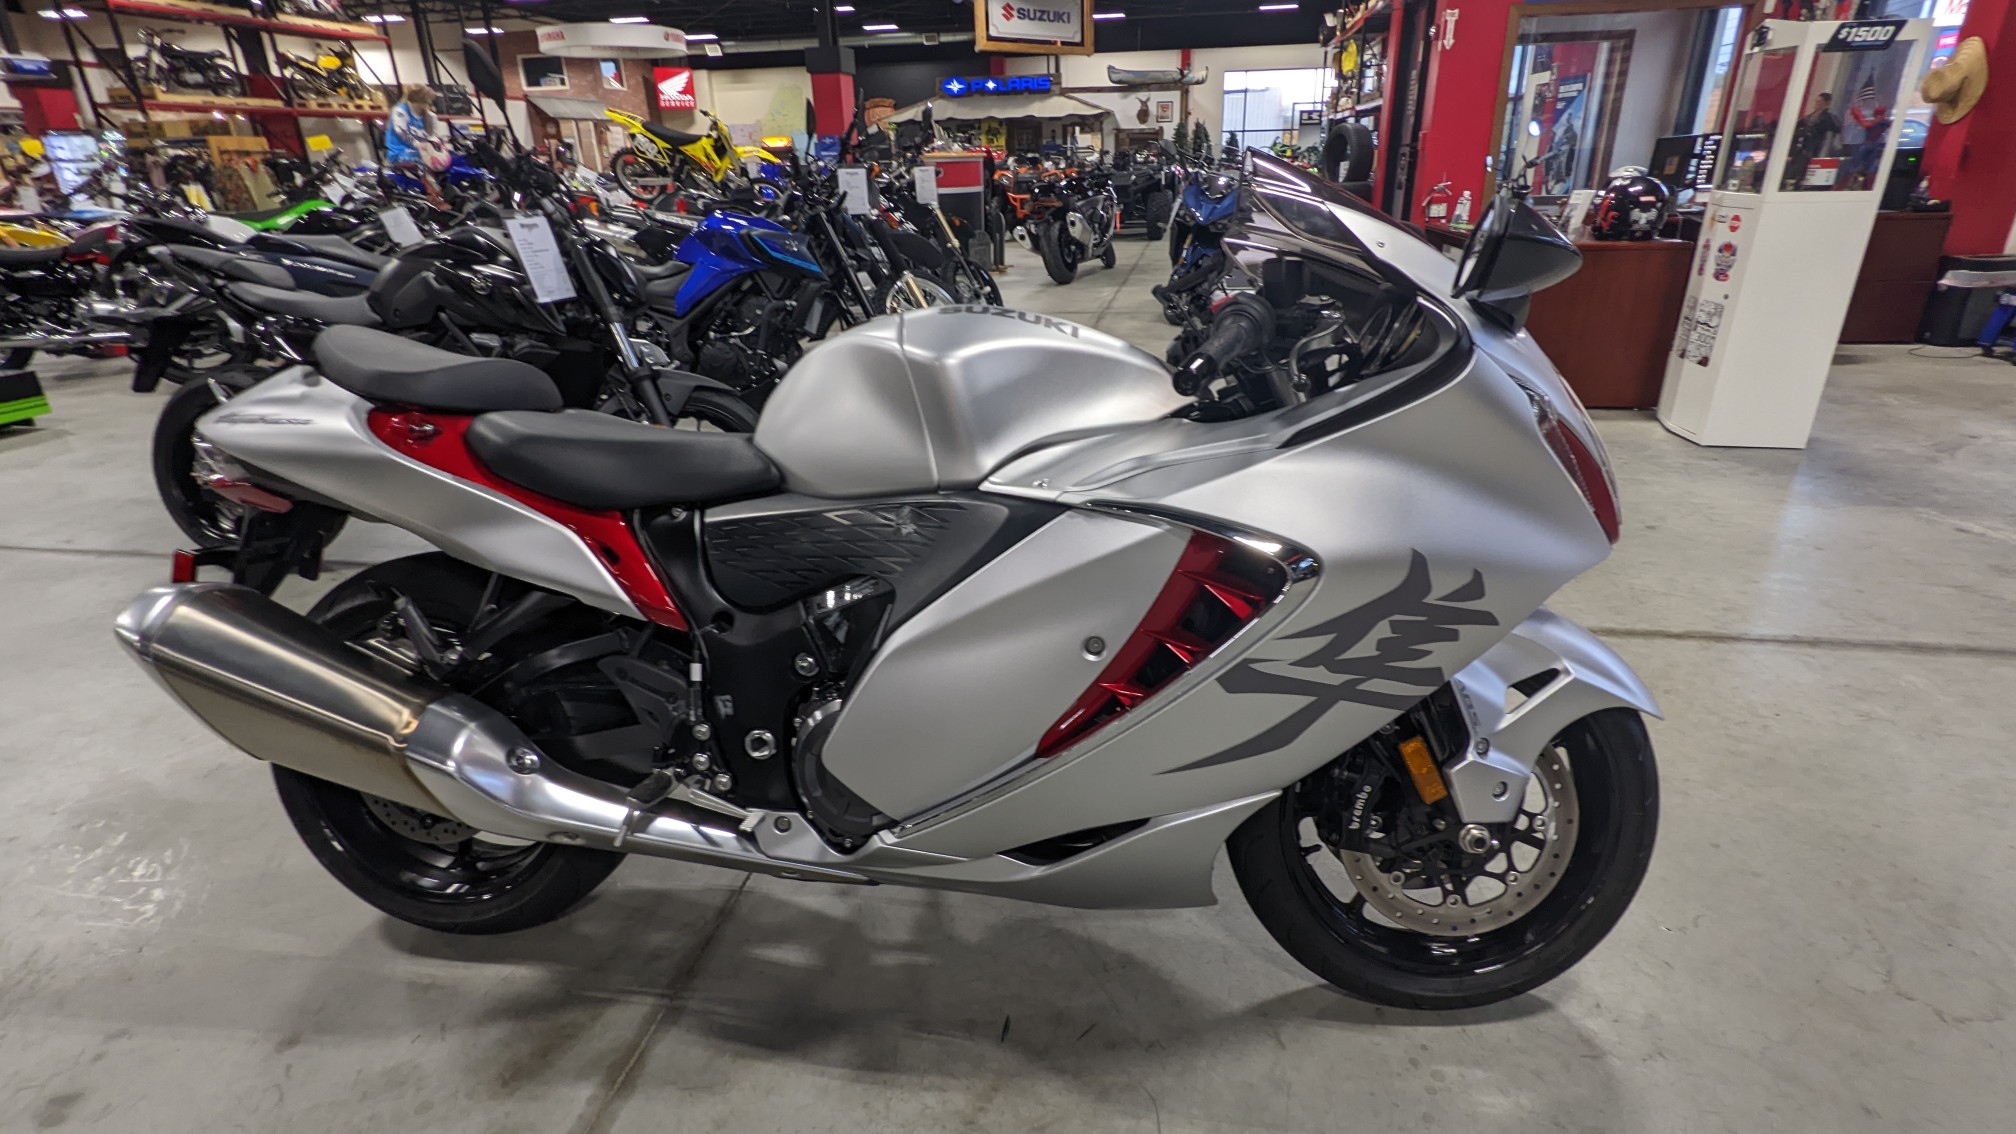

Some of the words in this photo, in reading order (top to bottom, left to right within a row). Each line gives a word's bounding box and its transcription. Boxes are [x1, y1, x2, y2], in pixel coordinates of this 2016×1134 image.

[1016, 7, 1071, 24] SUZUKI
[1838, 25, 1897, 42] $1500
[970, 76, 1053, 93] POLARIS
[660, 100, 696, 108] SERVICE
[938, 305, 1080, 339] SUZUKI
[1348, 784, 1373, 830] brembo
